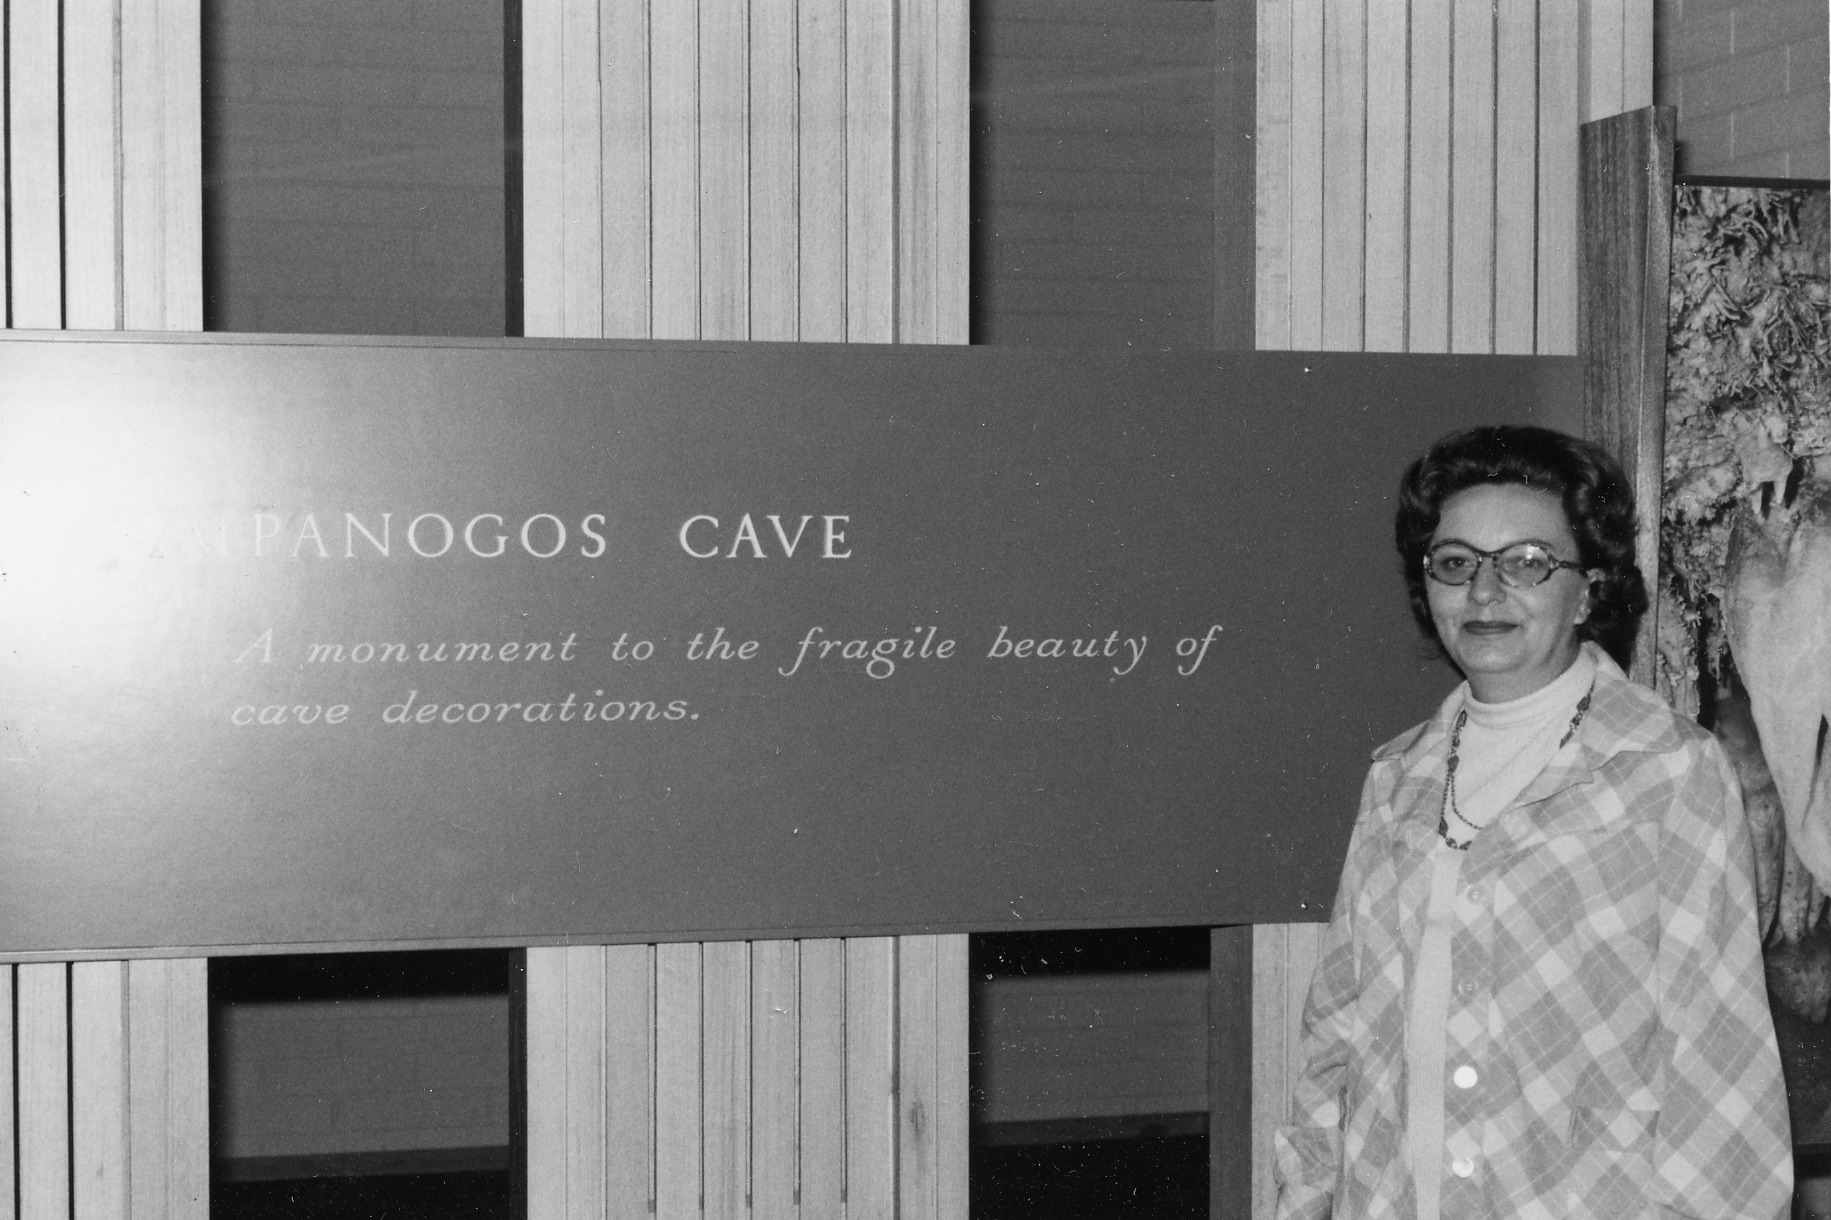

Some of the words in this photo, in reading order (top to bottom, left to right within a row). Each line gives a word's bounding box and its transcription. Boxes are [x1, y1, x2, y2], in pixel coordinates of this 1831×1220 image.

[678, 512, 853, 560] CAVE
[234, 628, 273, 664] A
[307, 631, 578, 664] monument
[611, 633, 655, 662] to
[686, 627, 760, 662] the
[778, 626, 957, 680] fragile
[987, 625, 1148, 676] beauty
[1176, 624, 1224, 677] of
[231, 704, 350, 726] cave
[383, 689, 700, 725] decorations.
